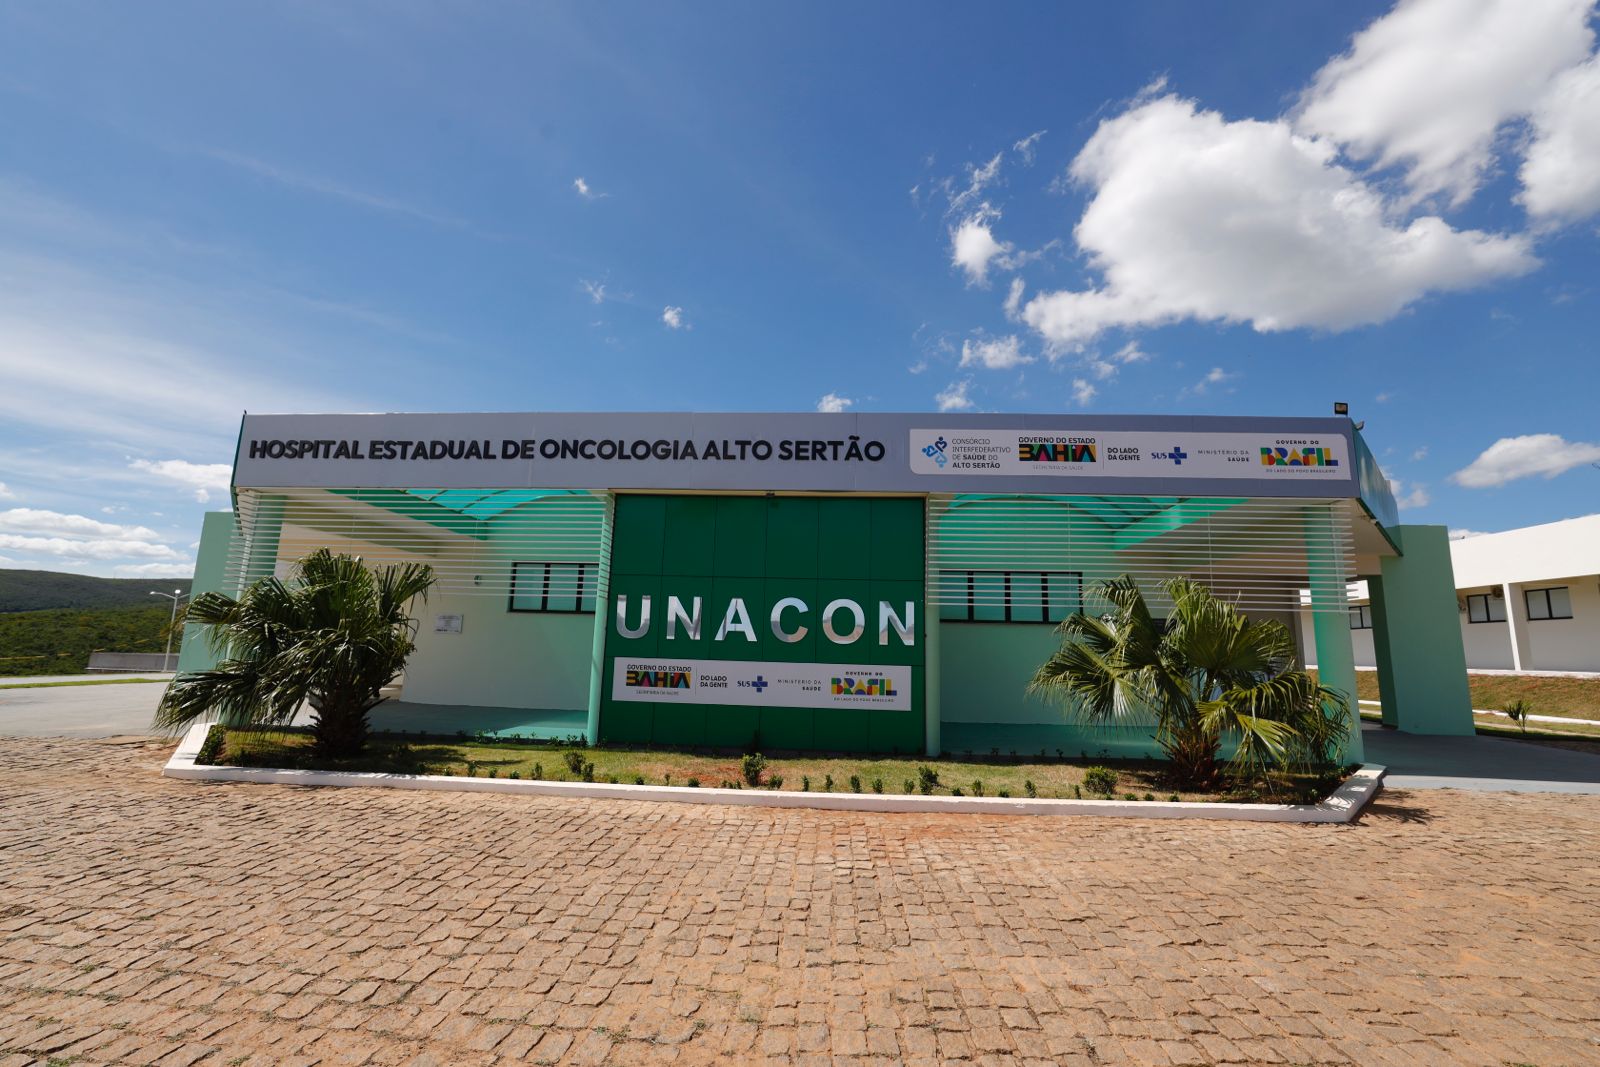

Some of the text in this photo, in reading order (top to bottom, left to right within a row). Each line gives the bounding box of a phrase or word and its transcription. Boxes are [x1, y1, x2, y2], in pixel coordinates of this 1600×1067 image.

[952, 437, 990, 445] CONSÓRCIO
[249, 435, 886, 462] HOSPITAL ESTADUAL DE ONCOLOGIA ALTO SERTÃO
[952, 446, 1011, 454] INTERFEDERATIVO
[963, 453, 986, 461] SAÚDE
[1151, 452, 1167, 460] SUS
[1260, 447, 1339, 467] BRASIL
[972, 461, 1001, 469] SERTÃO
[616, 594, 916, 647] UNACON
[831, 677, 897, 696] BRASIL
